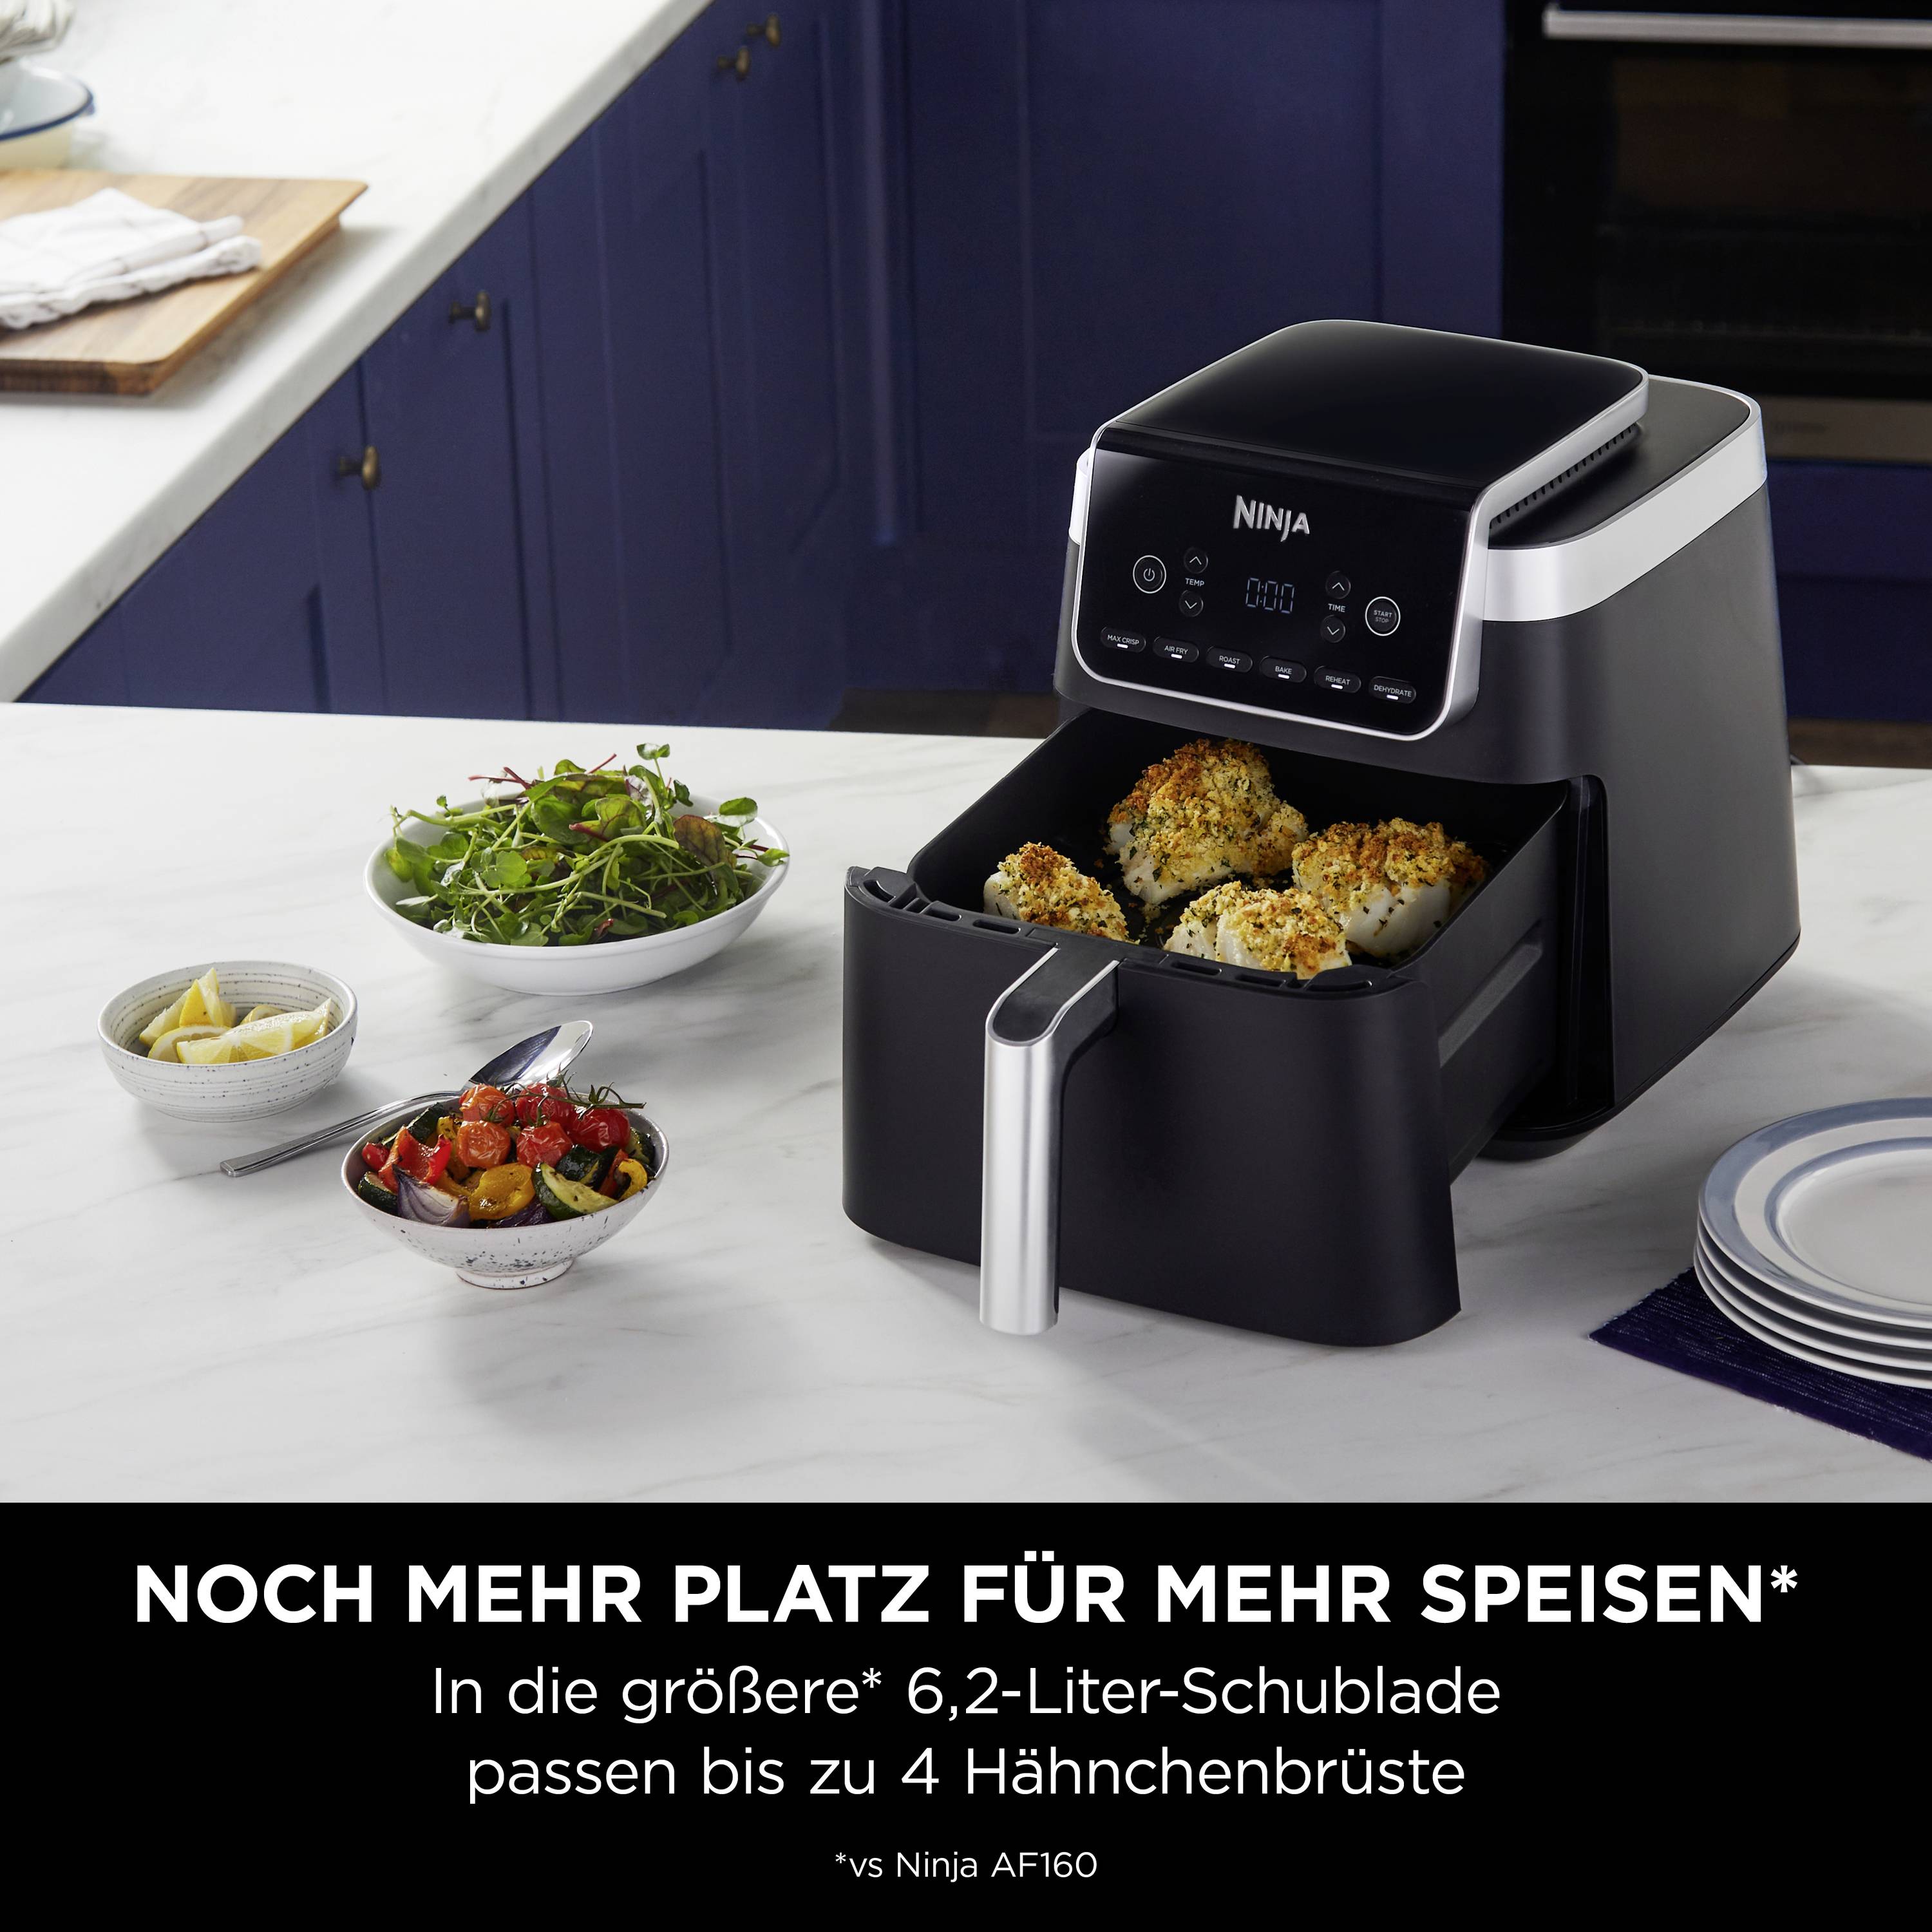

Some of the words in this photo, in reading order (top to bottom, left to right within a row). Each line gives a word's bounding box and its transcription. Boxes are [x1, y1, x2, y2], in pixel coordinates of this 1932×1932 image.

[1233, 495, 1310, 542] NINJA
[1185, 578, 1205, 587] TEMP
[1245, 577, 1295, 614] 0:00
[1328, 603, 1345, 612] TIME
[1374, 609, 1392, 618] START
[1107, 634, 1121, 643] MAX
[1122, 637, 1139, 645] CRISP
[1176, 647, 1188, 655] FRY
[1219, 655, 1241, 665] ROAST
[1275, 665, 1293, 674] BAKE
[1325, 675, 1350, 686] REHEAT
[1374, 684, 1412, 697] DEHYDRATE
